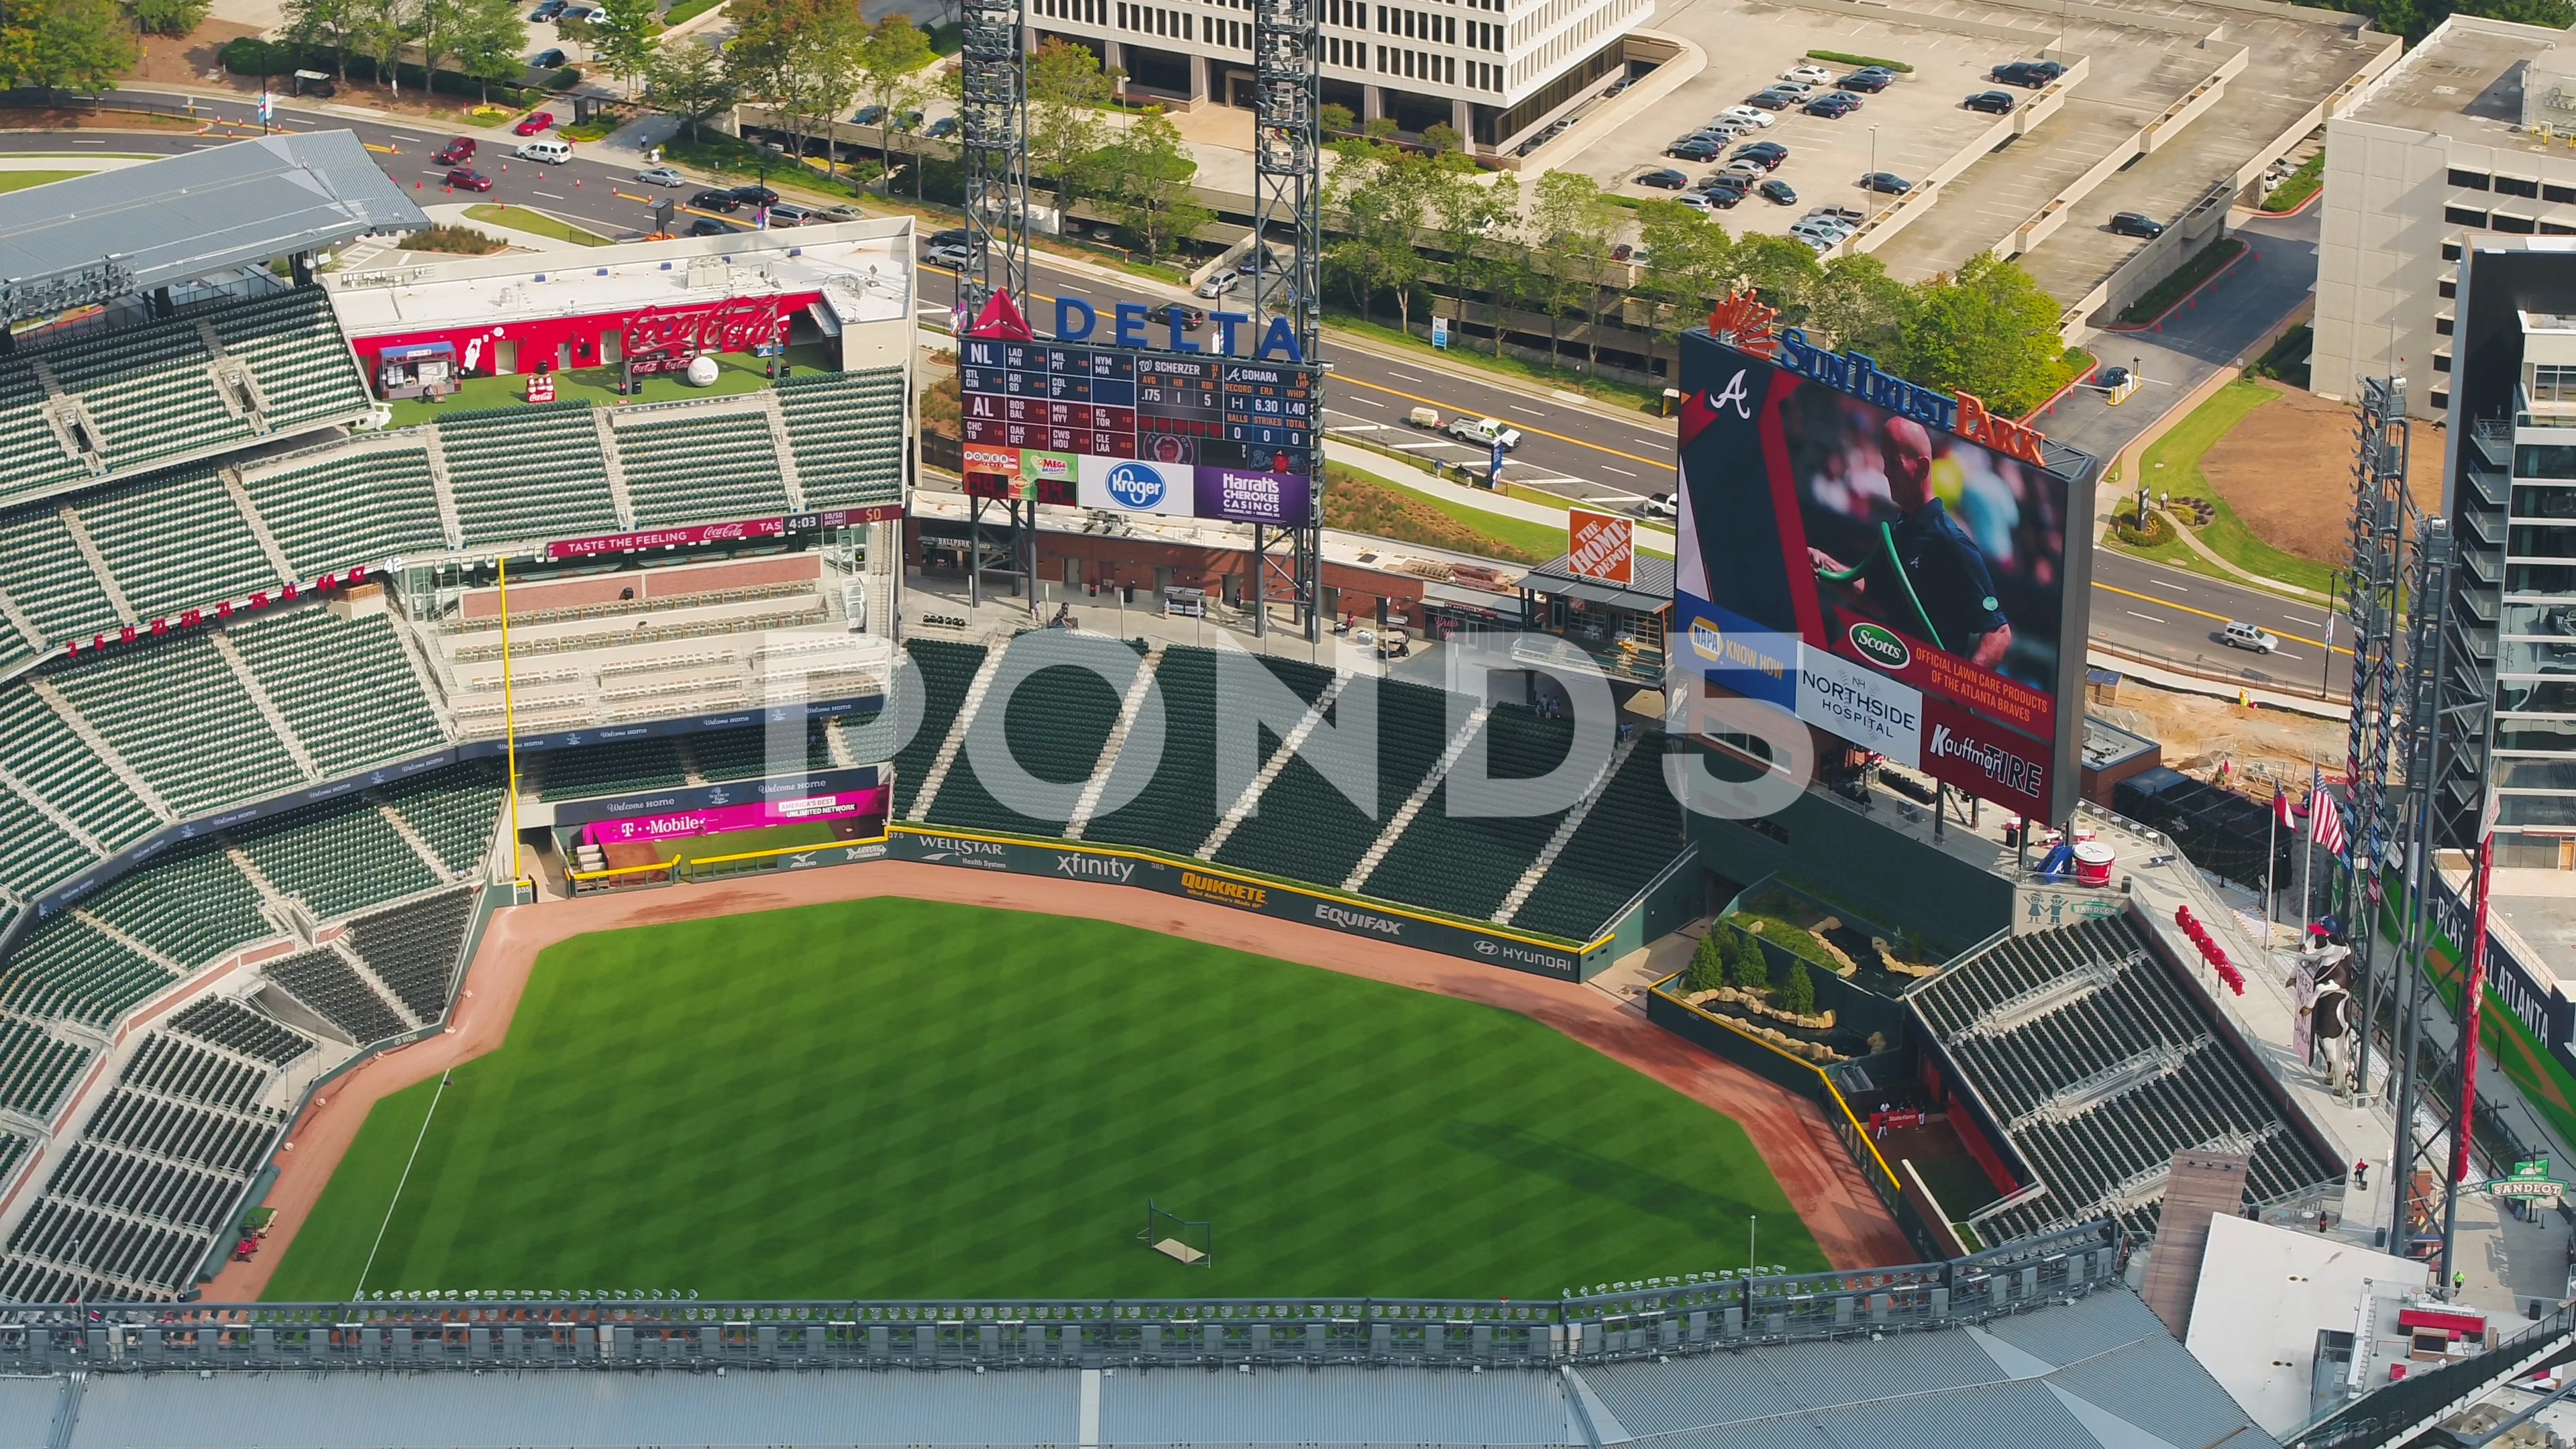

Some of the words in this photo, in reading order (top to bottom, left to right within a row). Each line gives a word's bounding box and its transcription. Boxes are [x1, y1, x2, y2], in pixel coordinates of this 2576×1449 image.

[1055, 297, 1303, 362] DELTA
[971, 343, 993, 364] NL
[1008, 347, 1022, 357] LAD
[1051, 352, 1065, 362] MIL
[1008, 357, 1022, 366] PHI
[1052, 362, 1064, 370] PIT
[1095, 356, 1112, 366] NYM
[966, 369, 979, 378] STL
[1095, 366, 1110, 375] MIA
[1155, 361, 1200, 376] SCHERZER
[1008, 374, 1022, 383] ARI
[1052, 378, 1067, 387] COL
[1142, 376, 1156, 384] AVG
[1173, 378, 1183, 387] HR
[1242, 370, 1278, 383] GOHARA
[966, 379, 979, 388] CIN
[1009, 383, 1019, 392] SD
[1201, 381, 1214, 389] RBI
[1225, 383, 1252, 393] RECORD
[1296, 380, 1309, 388] LHP
[1052, 387, 1061, 396] SF
[1141, 388, 1161, 401] .175
[1260, 386, 1273, 395] ERA
[1287, 389, 1305, 398] WHIP
[973, 396, 994, 417] AL
[1010, 400, 1025, 410] BOS
[1204, 394, 1211, 407] 5
[1232, 396, 1243, 409] 1-1
[1255, 398, 1278, 413] 6.30
[1010, 409, 1024, 419] BAL
[1053, 405, 1067, 414] MIN
[1095, 409, 1106, 417] KC
[1285, 402, 1305, 415] 1.40
[1053, 413, 1067, 423] NYY
[1095, 417, 1110, 427] TOR
[1227, 413, 1248, 423] BALLS
[1254, 416, 1282, 427] STRIKES
[1286, 419, 1306, 429] TOTAL
[967, 421, 982, 431] CHC
[1010, 425, 1025, 435] OAK
[967, 431, 977, 439] TB
[1053, 430, 1070, 439] CWS
[1096, 433, 1110, 443] CLE
[1234, 427, 1241, 439] 0
[1263, 429, 1270, 442] 0
[1292, 433, 1299, 445] 0
[1010, 435, 1024, 444] DET
[1053, 439, 1069, 448] HOU
[1096, 443, 1110, 452] LAA
[1043, 459, 1067, 468] MEGA
[1112, 468, 1161, 504] Kroger
[1223, 473, 1280, 494] Harrah's
[1223, 490, 1279, 503] CHEROKEE
[1223, 499, 1279, 513] CASINOS
[824, 512, 843, 521] 50/50
[865, 508, 881, 522] $0
[788, 515, 816, 529] 4:03
[1575, 520, 1601, 543] THE
[568, 539, 605, 553] TASTE
[609, 537, 632, 549] THE
[636, 531, 687, 547] FEELING
[1570, 519, 1632, 574] HOME
[384, 557, 402, 574] 42
[1593, 543, 1631, 578] DEPOT
[180, 609, 200, 628] 29
[119, 627, 137, 643] 10
[1694, 625, 1719, 653] NAPA
[94, 634, 105, 651] 6
[1858, 629, 1902, 659] Scotts
[1726, 639, 1757, 669] KNOW
[1760, 654, 1784, 680] HOW
[1916, 647, 1952, 673] OFFICIAL
[1953, 663, 1978, 683] LAWN
[1979, 674, 2000, 693] CARE
[2002, 684, 2047, 713] PRODUCTS
[1803, 669, 1916, 732] NORTHSIDE
[1931, 670, 1942, 684] OF
[1944, 674, 1960, 693] THE
[1961, 683, 1996, 709] ATLANTA
[1998, 699, 2031, 722] BRAVES
[1822, 698, 1894, 739] HOSPITAL
[1929, 723, 2002, 775] Kauffman
[1983, 743, 2043, 798] TIRE
[757, 783, 796, 794] Welcome
[606, 801, 644, 813] Welcome
[780, 799, 816, 811] AMERICA'S
[817, 798, 835, 806] BEST
[786, 808, 821, 818] UNLIMITED
[822, 804, 855, 814] NETWORK
[855, 845, 881, 855] ARROW
[918, 835, 1003, 856] WELLSTAR
[962, 857, 983, 867] Health
[984, 860, 1006, 869] System
[1057, 853, 1134, 883] xfinity
[1150, 862, 1165, 871] 385
[516, 885, 531, 893] 335
[1181, 872, 1267, 904] QUIKRETE
[1187, 889, 1203, 898] What
[1234, 898, 1251, 906] Made
[1315, 904, 1403, 936] EQUIFAX
[2436, 895, 2467, 953] PLAY
[1503, 946, 1572, 971] HYUNDAI
[2497, 965, 2548, 1049] ATLANTA
[2494, 1184, 2561, 1194] SANDLOT
